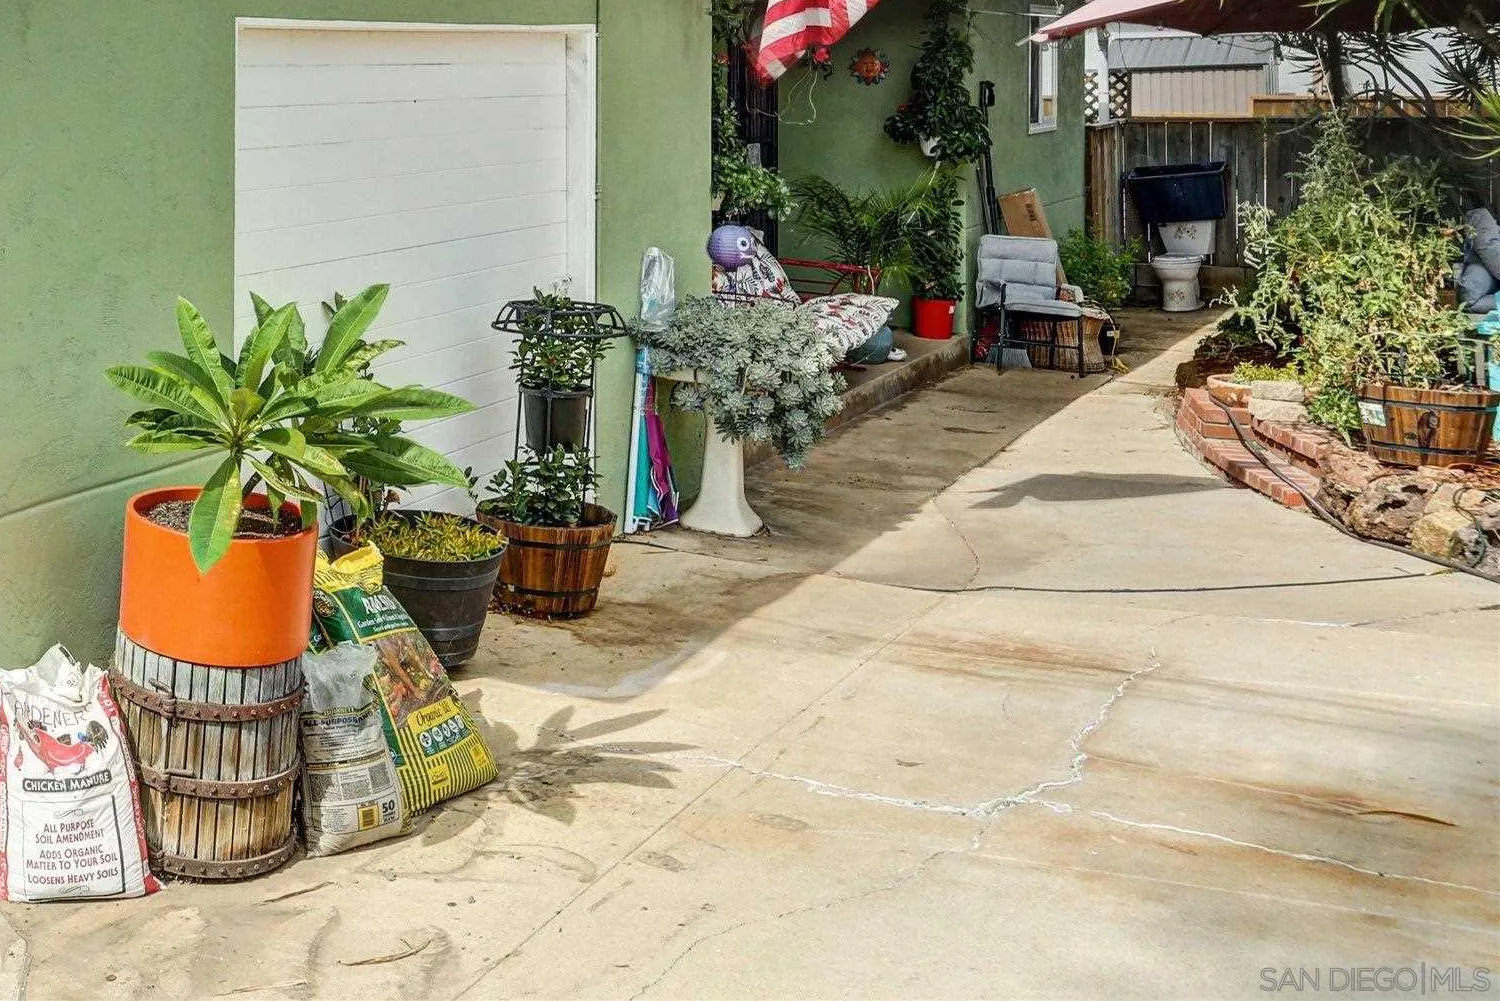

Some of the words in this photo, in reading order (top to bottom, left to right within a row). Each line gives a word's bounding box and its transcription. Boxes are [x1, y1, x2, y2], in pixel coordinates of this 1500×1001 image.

[24, 778, 67, 790] CHICKEN
[70, 772, 110, 788] MANURE
[382, 799, 395, 813] 50
[43, 823, 58, 833] ALL
[60, 818, 94, 832] PURPOSE
[35, 833, 53, 844] SOIL
[56, 828, 105, 844] AMENDMENT
[39, 849, 62, 859] ADDS
[64, 843, 104, 859] ORGANIC
[26, 859, 57, 871] MATTER
[59, 860, 71, 870] TO
[74, 857, 98, 869] YOUR
[100, 852, 118, 865] SOIL
[27, 873, 65, 885] LOOSENS
[67, 872, 95, 884] HEAVY
[96, 866, 119, 880] SOILS
